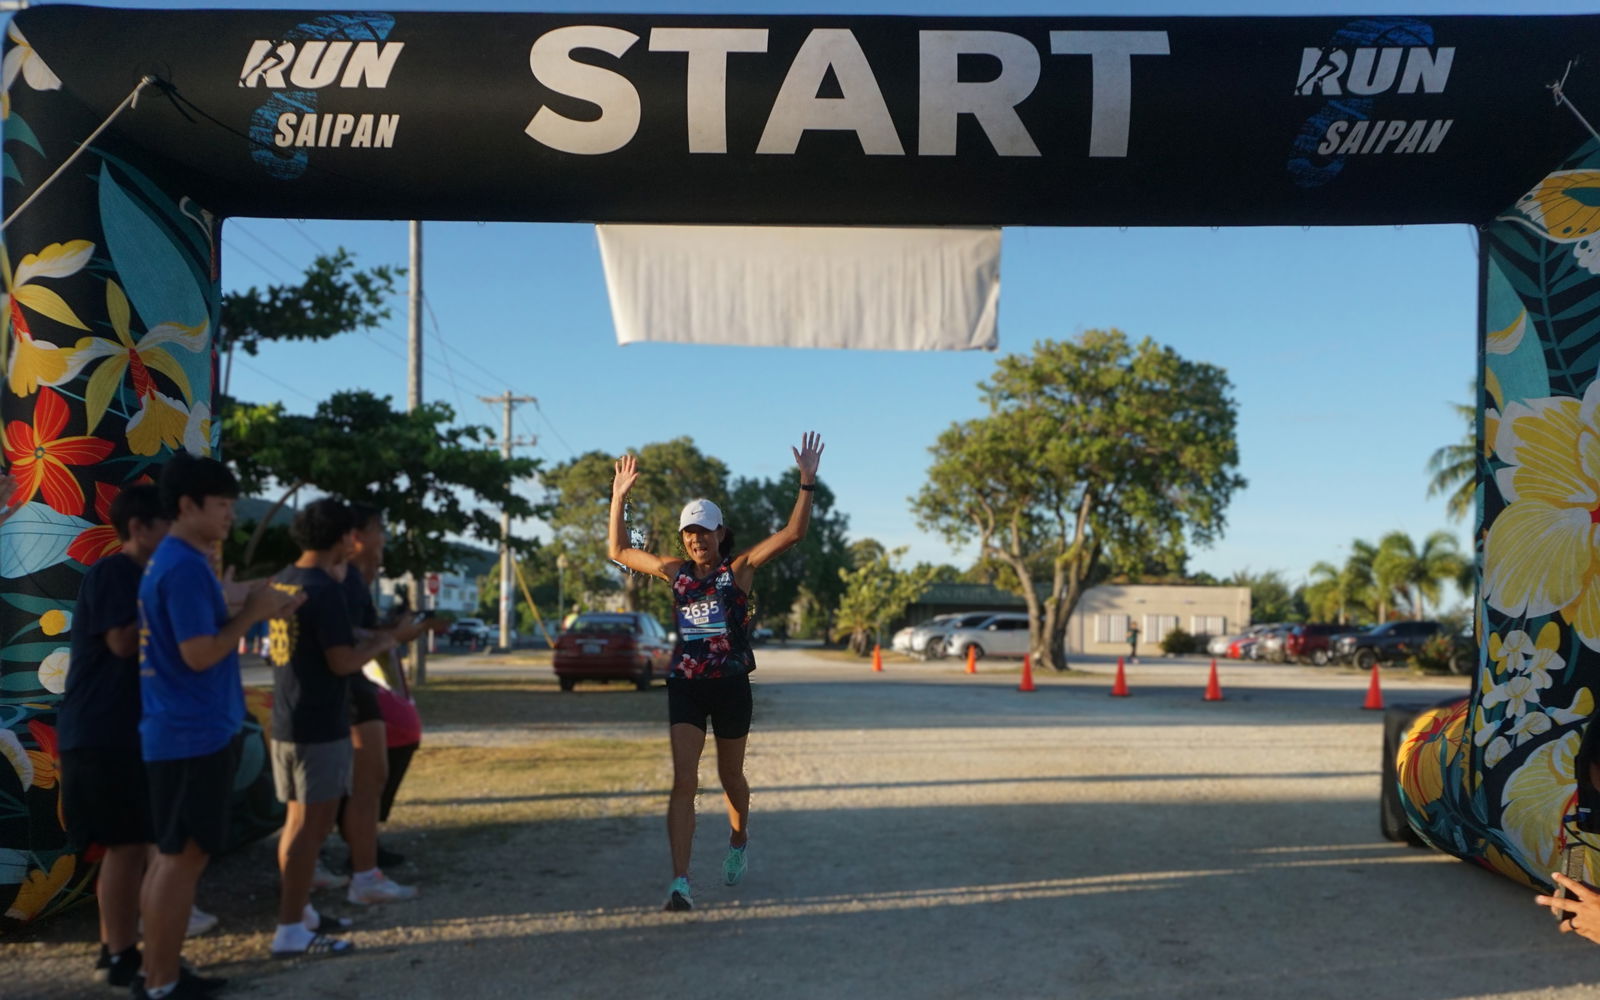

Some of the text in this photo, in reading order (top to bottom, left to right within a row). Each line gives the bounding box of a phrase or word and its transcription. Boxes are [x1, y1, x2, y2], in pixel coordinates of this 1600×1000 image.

[238, 40, 405, 88] RUN
[1294, 47, 1456, 95] RUN
[524, 25, 1170, 157] START
[275, 113, 399, 148] SAIPAN
[1317, 119, 1454, 155] SAIPAN
[681, 601, 719, 619] 2635
